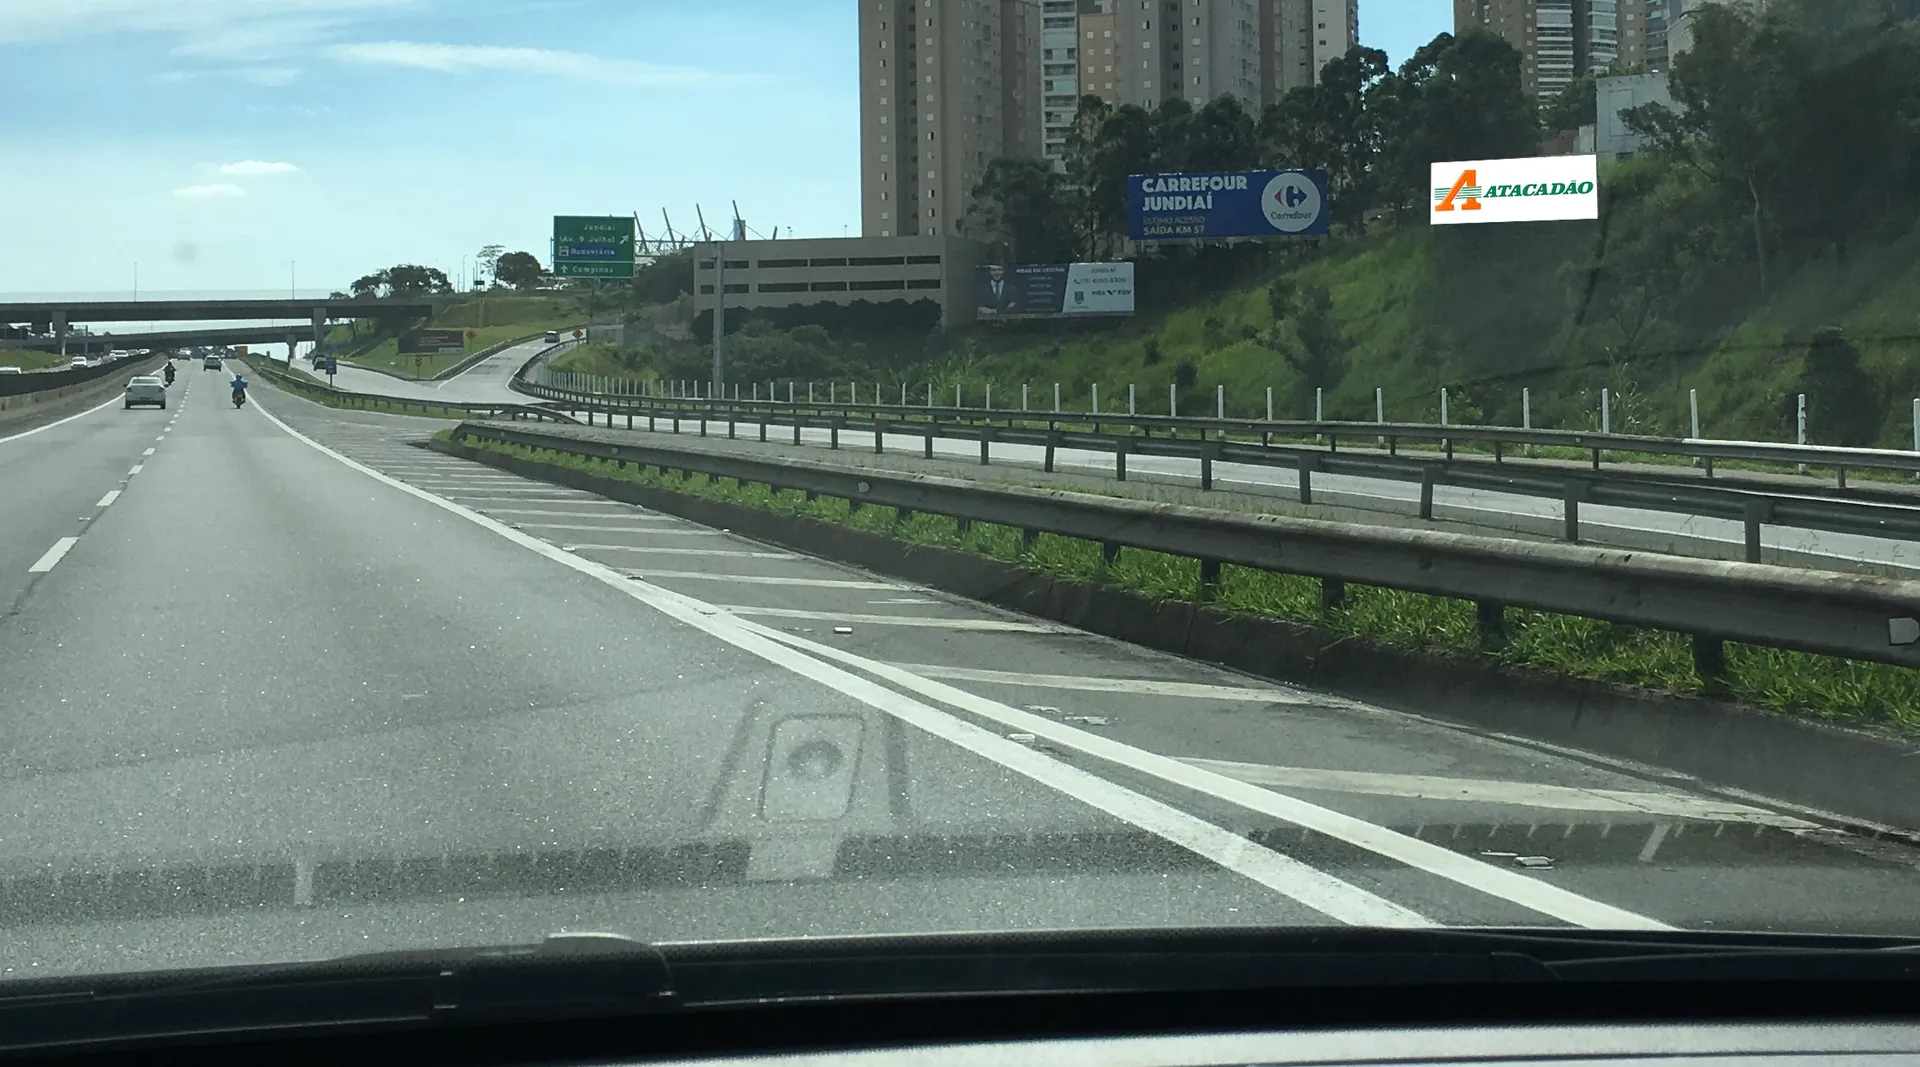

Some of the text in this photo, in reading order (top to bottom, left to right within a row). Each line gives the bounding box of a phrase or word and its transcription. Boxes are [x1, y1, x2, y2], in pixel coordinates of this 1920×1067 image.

[1142, 176, 1248, 193] CARREFOUR
[1483, 180, 1594, 198] ATACADÃO
[1142, 192, 1213, 212] JUNDIAÍ
[1270, 212, 1312, 220] Carrefour
[1143, 225, 1206, 236] SAÍDA KM 57
[572, 266, 614, 274] Campinas
